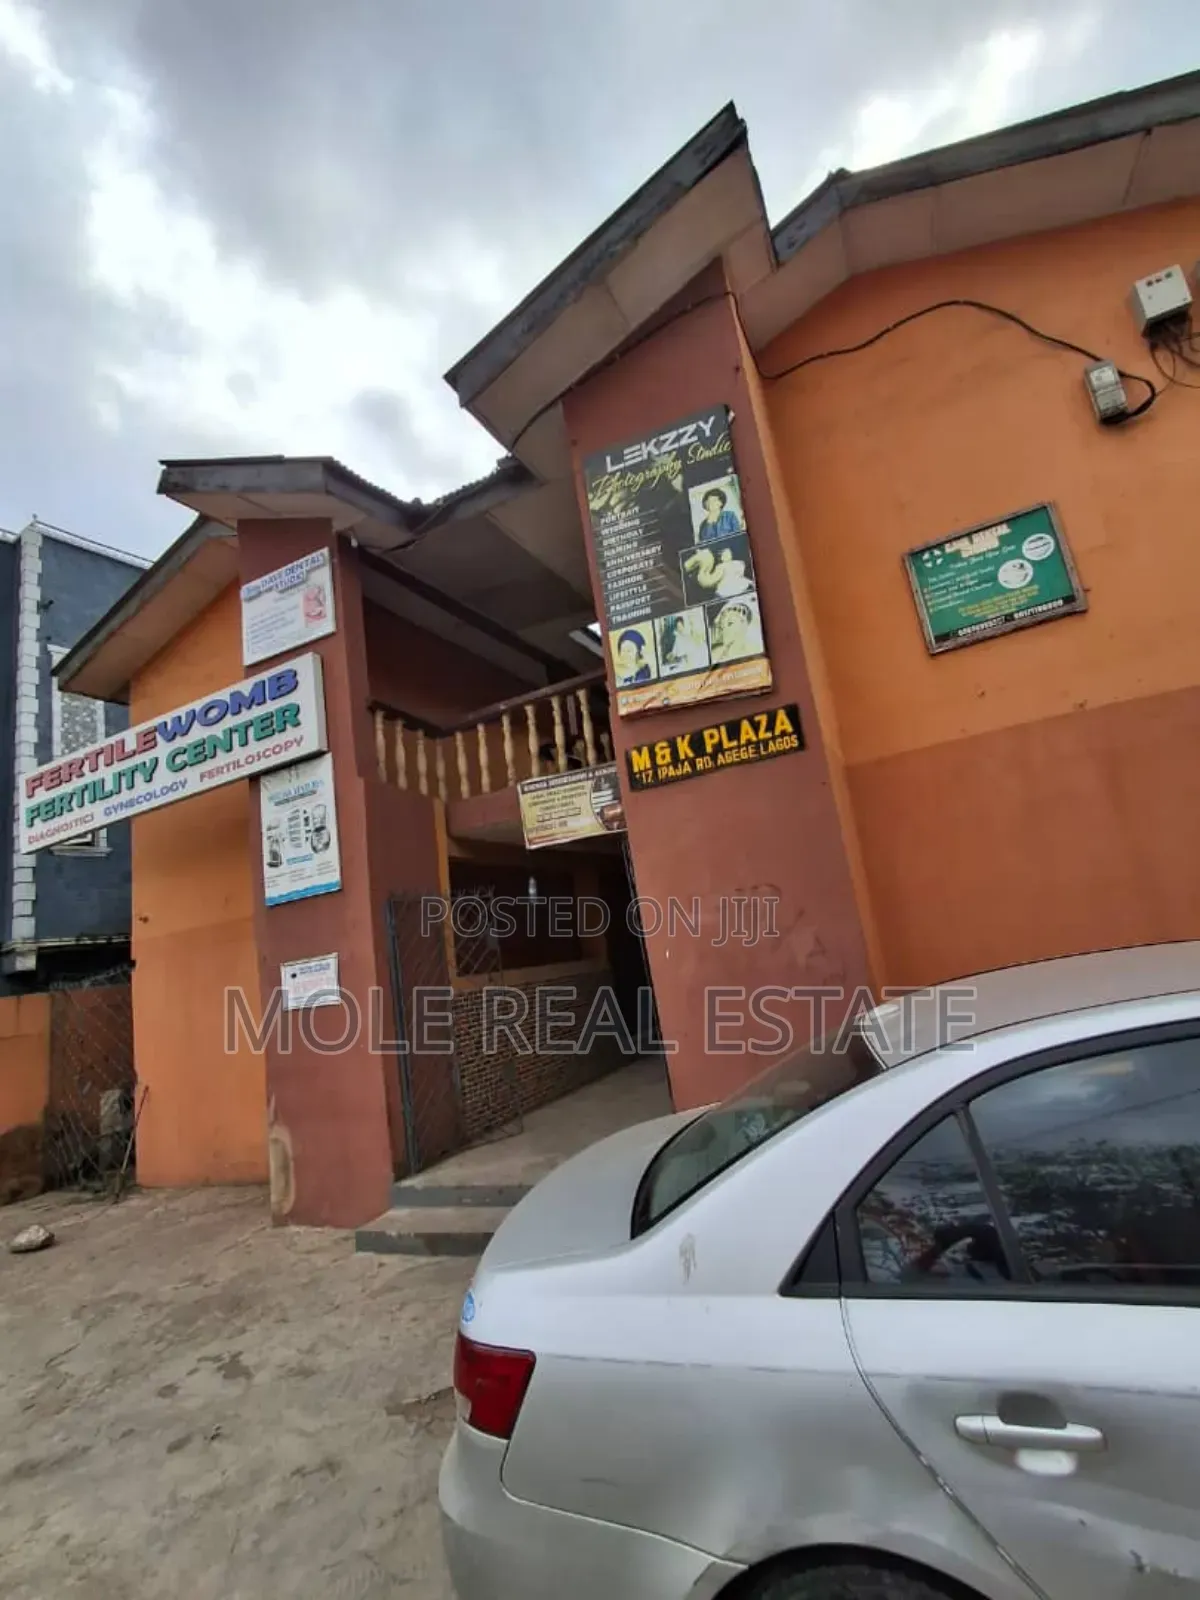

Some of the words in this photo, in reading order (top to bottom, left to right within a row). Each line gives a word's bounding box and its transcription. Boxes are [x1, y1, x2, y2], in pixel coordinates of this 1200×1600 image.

[605, 415, 716, 473] LEKZZY
[24, 667, 299, 799] FERTILEWOMB
[24, 755, 159, 829] FERTILITY
[166, 701, 302, 774] CENTER
[658, 763, 692, 781] IPAJA
[716, 743, 758, 766] AGEGE
[760, 734, 799, 756] LAGOS
[702, 708, 794, 754] PLAZA
[103, 778, 188, 818] GYNECOLOGY
[200, 734, 304, 783] FERTILOSCOPY
